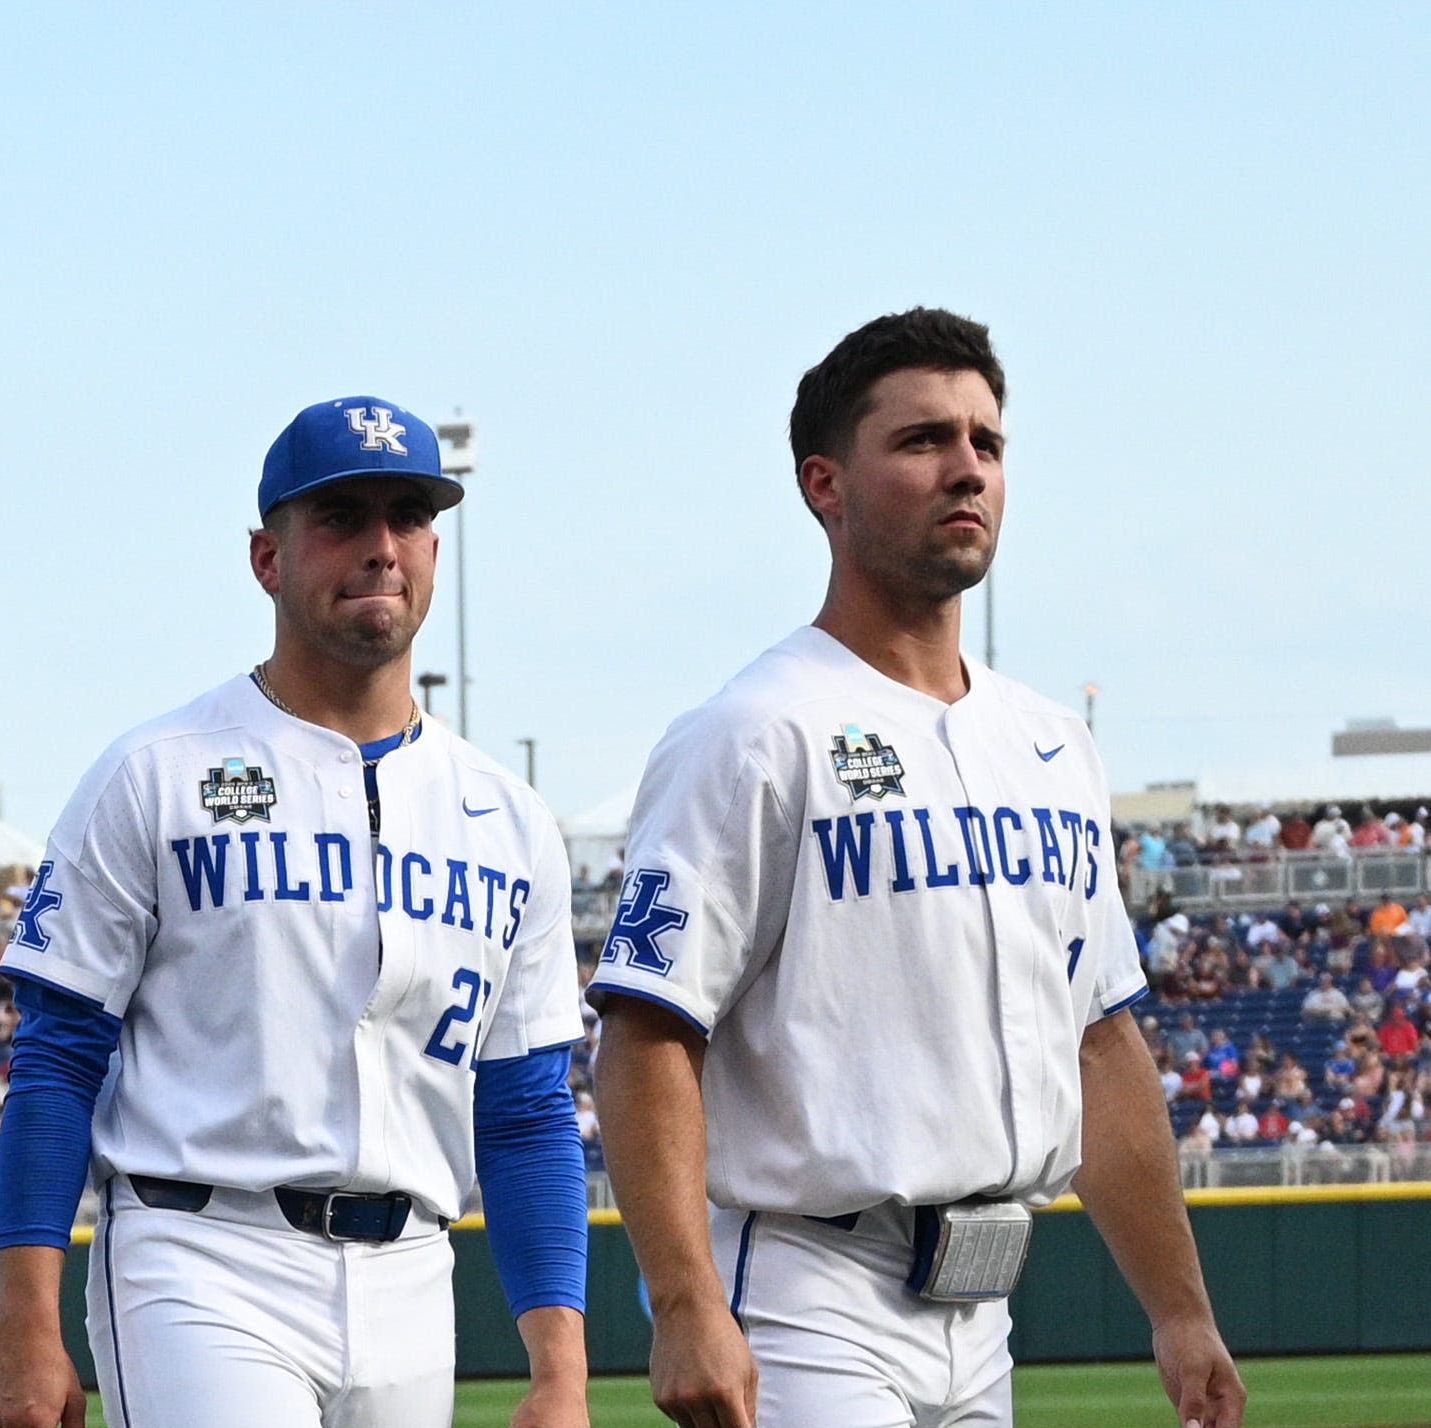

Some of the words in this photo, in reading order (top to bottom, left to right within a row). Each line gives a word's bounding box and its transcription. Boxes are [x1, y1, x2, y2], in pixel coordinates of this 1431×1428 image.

[344, 406, 408, 457] UK
[846, 755, 885, 769] COLLEGE
[838, 767, 871, 781] WORLD
[869, 764, 903, 778] SERIES
[217, 785, 258, 796] COLLEGE
[203, 794, 239, 807] WORLD
[239, 793, 275, 805] SERIES
[812, 806, 1101, 902] WILDCATS
[171, 831, 530, 950] WILDCATS
